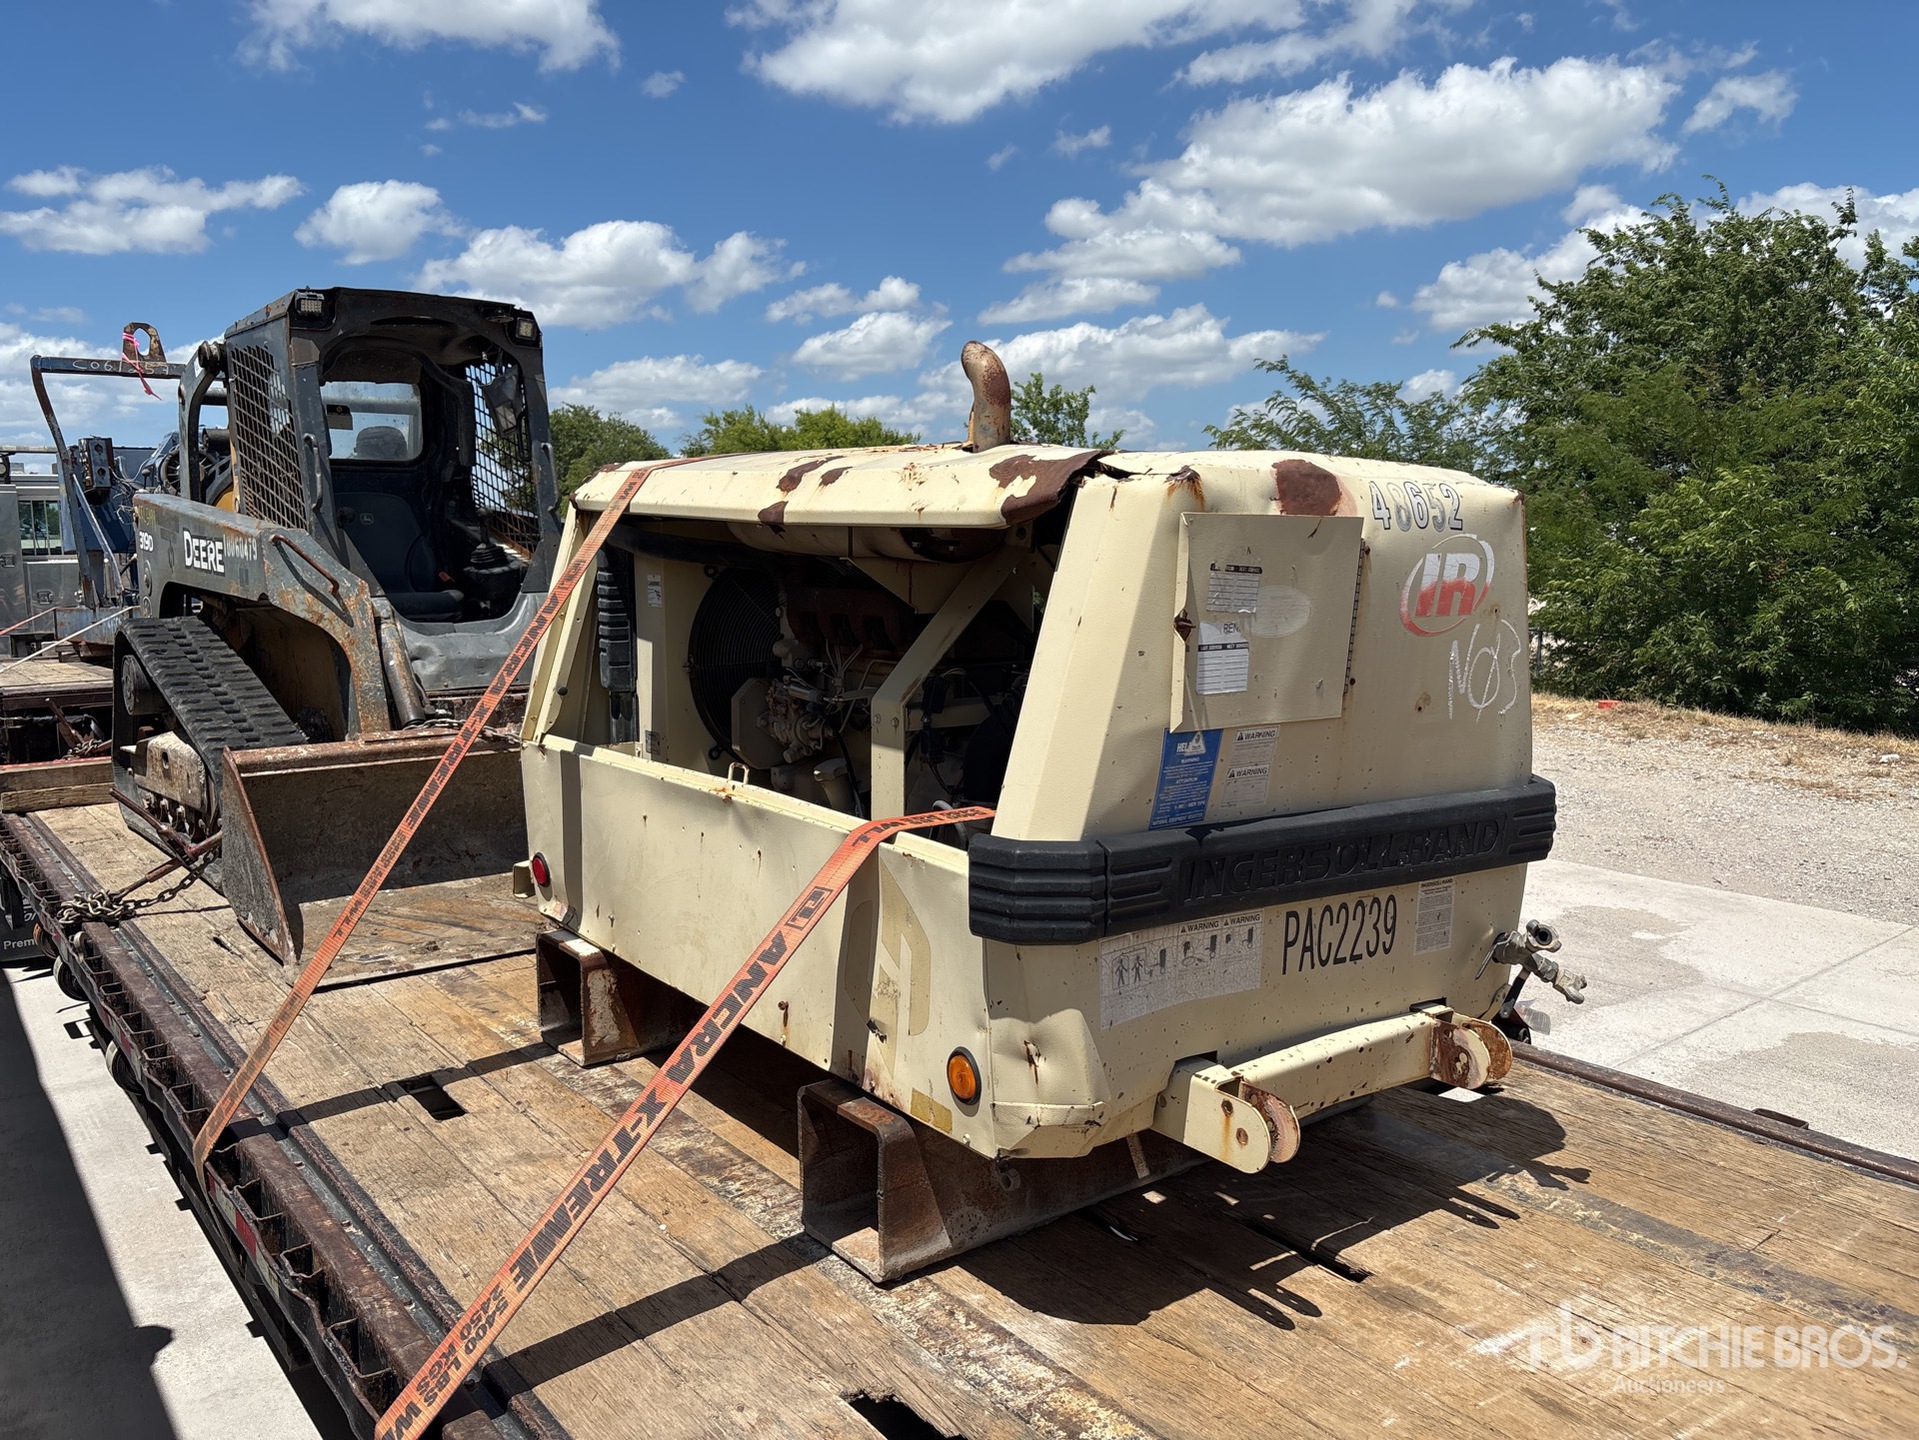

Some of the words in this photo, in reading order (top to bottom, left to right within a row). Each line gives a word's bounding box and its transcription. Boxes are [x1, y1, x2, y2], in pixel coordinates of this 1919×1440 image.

[1369, 480, 1463, 532] 48652
[183, 530, 225, 573] DEERE
[1414, 552, 1481, 617] IR
[489, 591, 559, 696] ANCRA
[1245, 730, 1276, 741] WARNING
[404, 701, 490, 830] X-TREME
[1236, 766, 1268, 777] WARNING
[1187, 921, 1219, 932] WARNING
[1230, 914, 1261, 925] WARNING
[1282, 894, 1397, 975] PAC2239
[662, 930, 785, 1085] ANCRA
[503, 1086, 667, 1293] X-TREME
[456, 1285, 502, 1342] 2450
[461, 1296, 510, 1356] 5400
[413, 1340, 458, 1397] KGS
[421, 1355, 463, 1408] LBS
